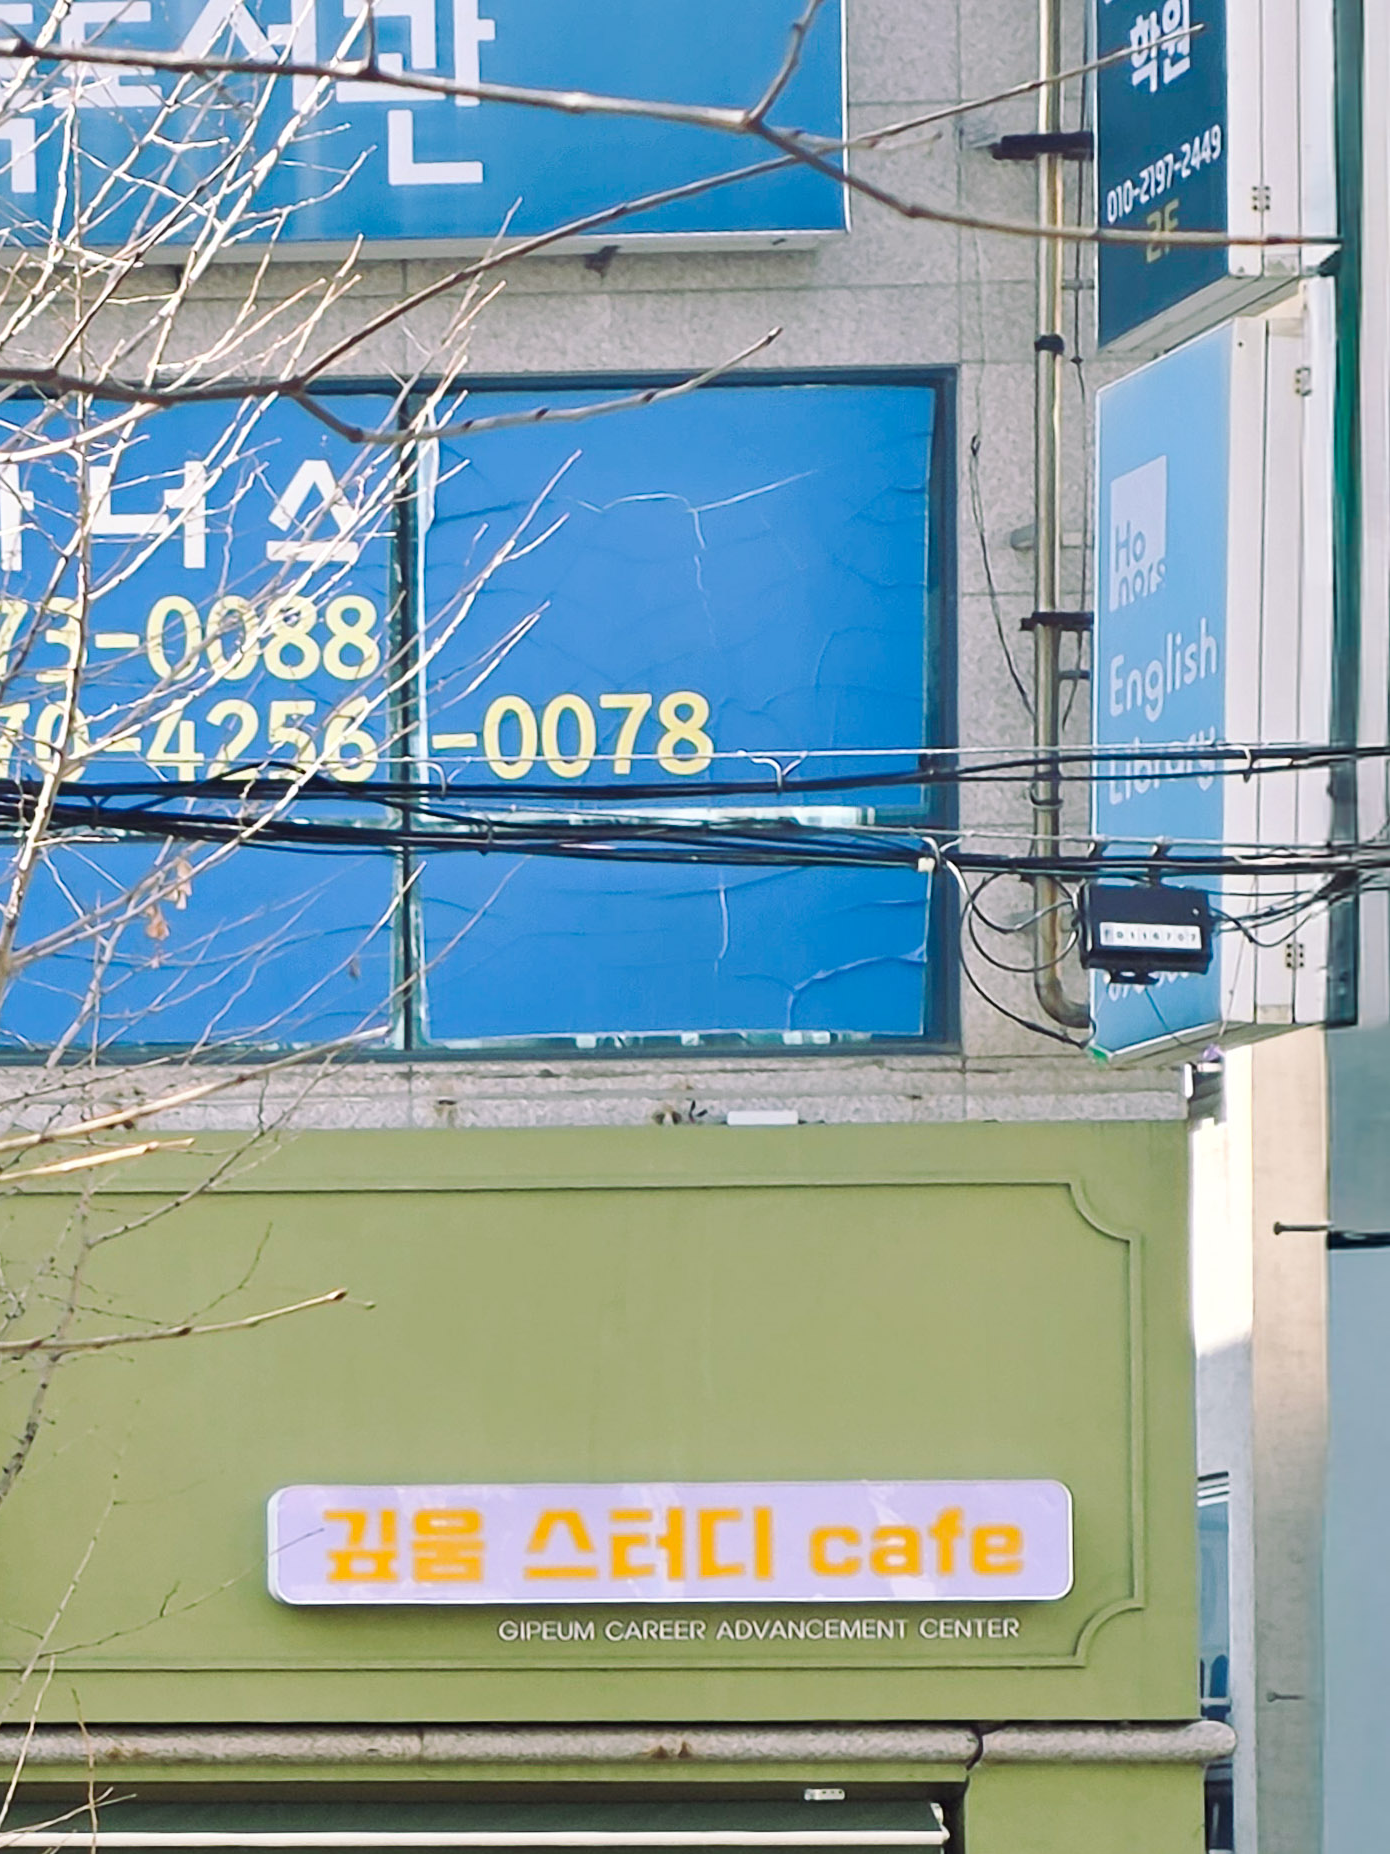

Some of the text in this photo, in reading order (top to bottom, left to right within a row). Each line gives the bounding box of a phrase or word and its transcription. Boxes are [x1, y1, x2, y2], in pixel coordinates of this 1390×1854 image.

[1130, 0, 1191, 93] 학원
[1106, 124, 1222, 225] 010-2197-2449
[1111, 617, 1218, 722] English
[523, 1506, 774, 1583] 스터디
[809, 1505, 1025, 1578] cafe
[497, 1617, 1020, 1643] GIPEUM CAREER ADVANCEMENT CENTER
